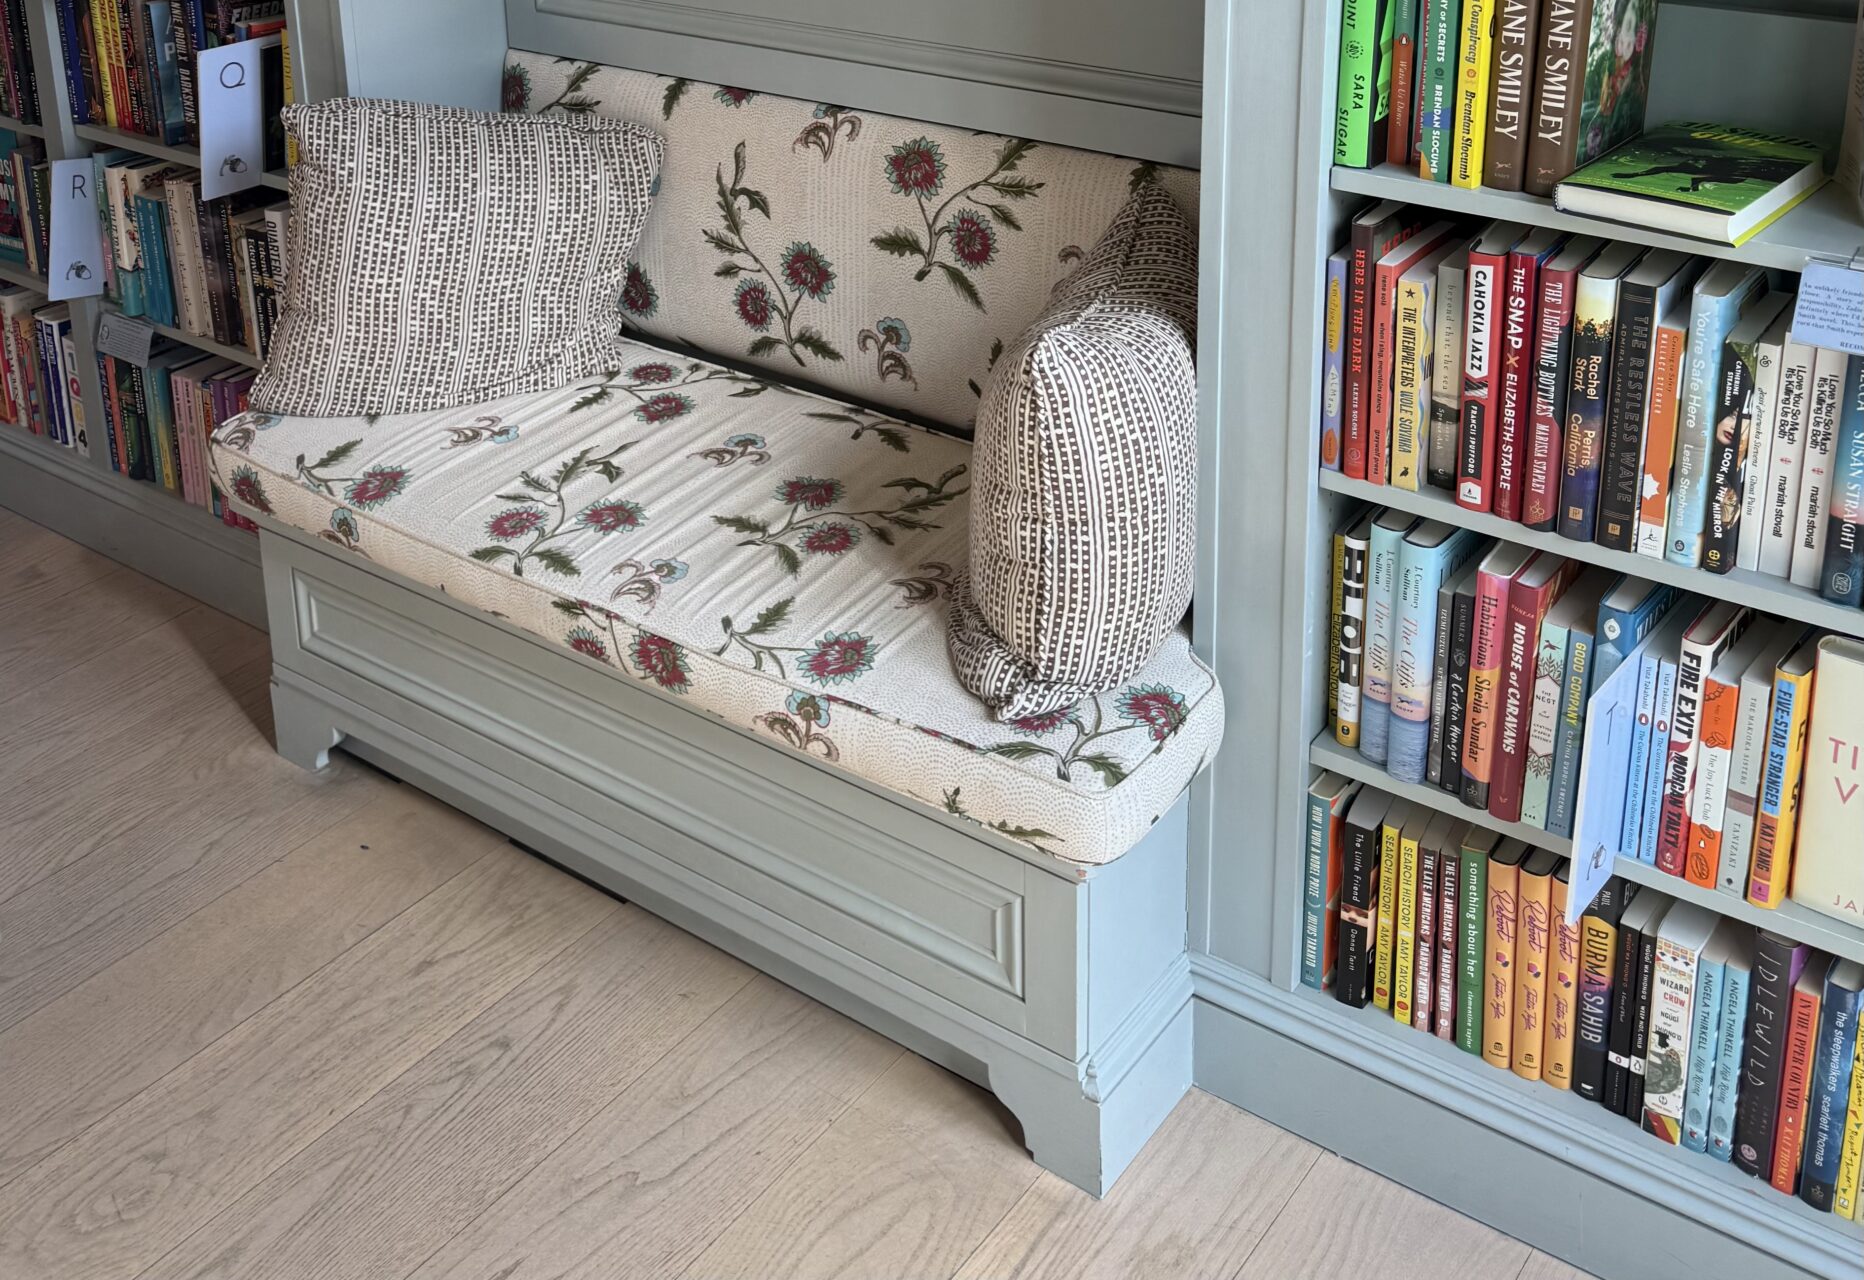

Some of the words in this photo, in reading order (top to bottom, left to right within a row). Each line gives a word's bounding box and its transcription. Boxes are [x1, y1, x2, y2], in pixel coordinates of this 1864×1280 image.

[175, 30, 188, 62] PROULX
[1436, 22, 1447, 62] SECRETS
[1465, 4, 1482, 64] Conspiracy
[180, 68, 196, 124] BARKSKINS
[219, 61, 246, 89] Q
[1351, 73, 1365, 111] SARA
[1494, 47, 1525, 141] SMILEY
[1434, 85, 1443, 128] BRENDAN
[1538, 55, 1571, 147] SMILEY
[1336, 107, 1349, 157] SLIGAR
[1431, 129, 1440, 174] SLOCUMB
[72, 174, 87, 200] R
[1513, 267, 1525, 293] THE
[1402, 308, 1416, 323] THE
[1471, 270, 1487, 336] CAHOKIA
[1506, 296, 1526, 350] SNAP
[1399, 324, 1416, 388] INTERPRETERS
[1467, 339, 1483, 372] JAZZ
[1575, 358, 1587, 392] Stark
[1587, 355, 1603, 401] Rachel
[1725, 371, 1735, 406] STEADMAN
[1732, 360, 1743, 396] CATHERINE
[1566, 413, 1583, 476] California
[1721, 447, 1734, 470] LOOK
[1848, 431, 1864, 475] SUSAN
[1718, 487, 1728, 503] THE
[1720, 472, 1729, 486] IN
[1713, 502, 1726, 539] MIRROR
[1840, 478, 1861, 552] STRAIGHT
[1477, 594, 1499, 667] Habitations
[1510, 622, 1526, 671] HOUSE
[1573, 642, 1587, 673] GOOD
[1678, 650, 1702, 693] FIRE
[1502, 690, 1520, 754] CARAVANS
[1565, 675, 1584, 727] COMPANY
[1675, 698, 1697, 739] EXIT
[1774, 688, 1794, 749] FIVE-STAR
[1668, 753, 1688, 808] MORGAN
[1769, 751, 1786, 808] STRANGER
[1664, 812, 1681, 848] TALTY
[1383, 834, 1394, 871] SEARCH
[1382, 874, 1393, 916] HISTORY
[1466, 862, 1479, 918] something
[1467, 923, 1477, 957] about
[1582, 926, 1609, 991] BURMA
[1467, 959, 1477, 978] her
[1581, 993, 1605, 1043] SAHIB
[1748, 951, 1778, 1087] IDLEWILD
[1836, 1011, 1848, 1028] the
[1828, 1029, 1846, 1092] sleepwalkers
[1820, 1095, 1831, 1131] scarlett
[1815, 1133, 1830, 1166] thomas
